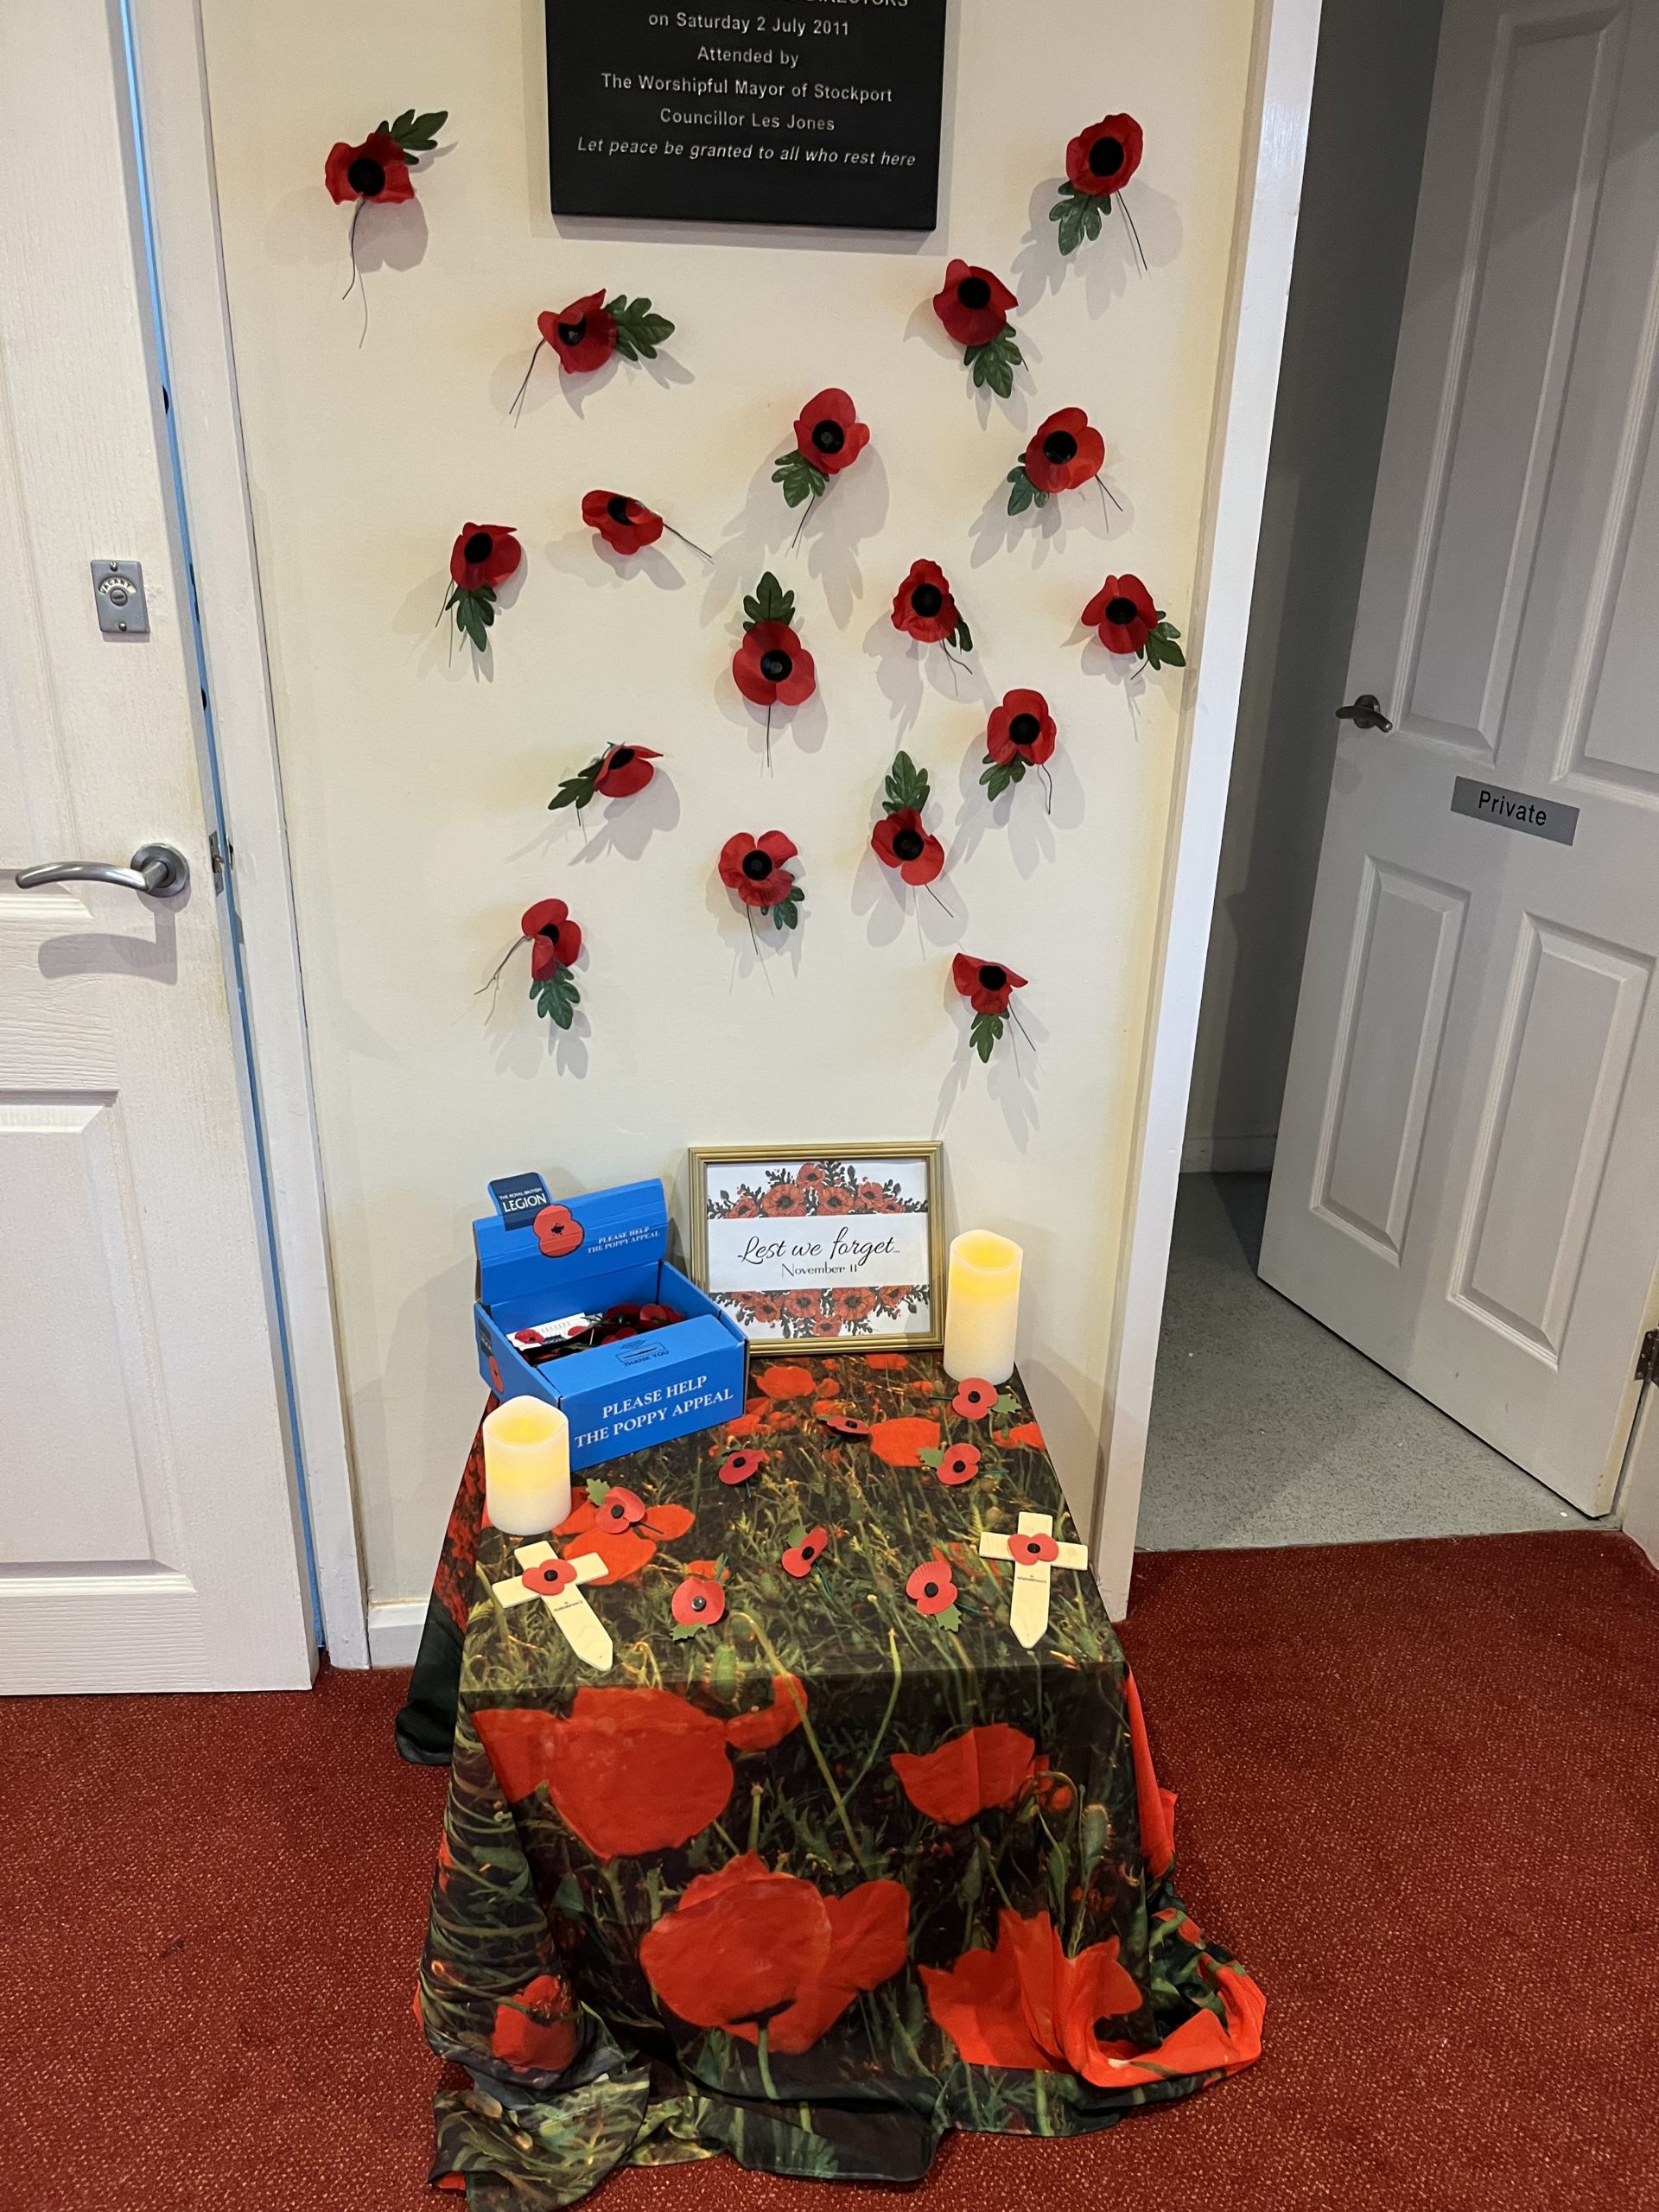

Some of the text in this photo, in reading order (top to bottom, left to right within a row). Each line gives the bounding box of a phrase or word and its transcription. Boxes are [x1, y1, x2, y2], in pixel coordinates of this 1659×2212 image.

[648, 12, 849, 36] on Saturday 2 July 2011
[697, 46, 799, 68] Attended by
[601, 73, 893, 104] The Worshipful Mayor of Stockport
[660, 107, 835, 130] Councillor Les Jones
[577, 137, 916, 167] Let peace be granted to all who rest here
[1478, 790, 1547, 826] Private
[502, 1192, 547, 1212] LEGION
[588, 1230, 660, 1254] THE POPPY APPEAL
[598, 1225, 650, 1244] PLEASE HELP
[737, 1236, 787, 1265] Lest
[791, 1242, 823, 1256] we
[781, 1261, 846, 1278] November
[623, 1357, 652, 1367] THANK
[602, 1375, 708, 1419] PLEASE HELP
[574, 1388, 734, 1448] THE POPPY APPEAL
